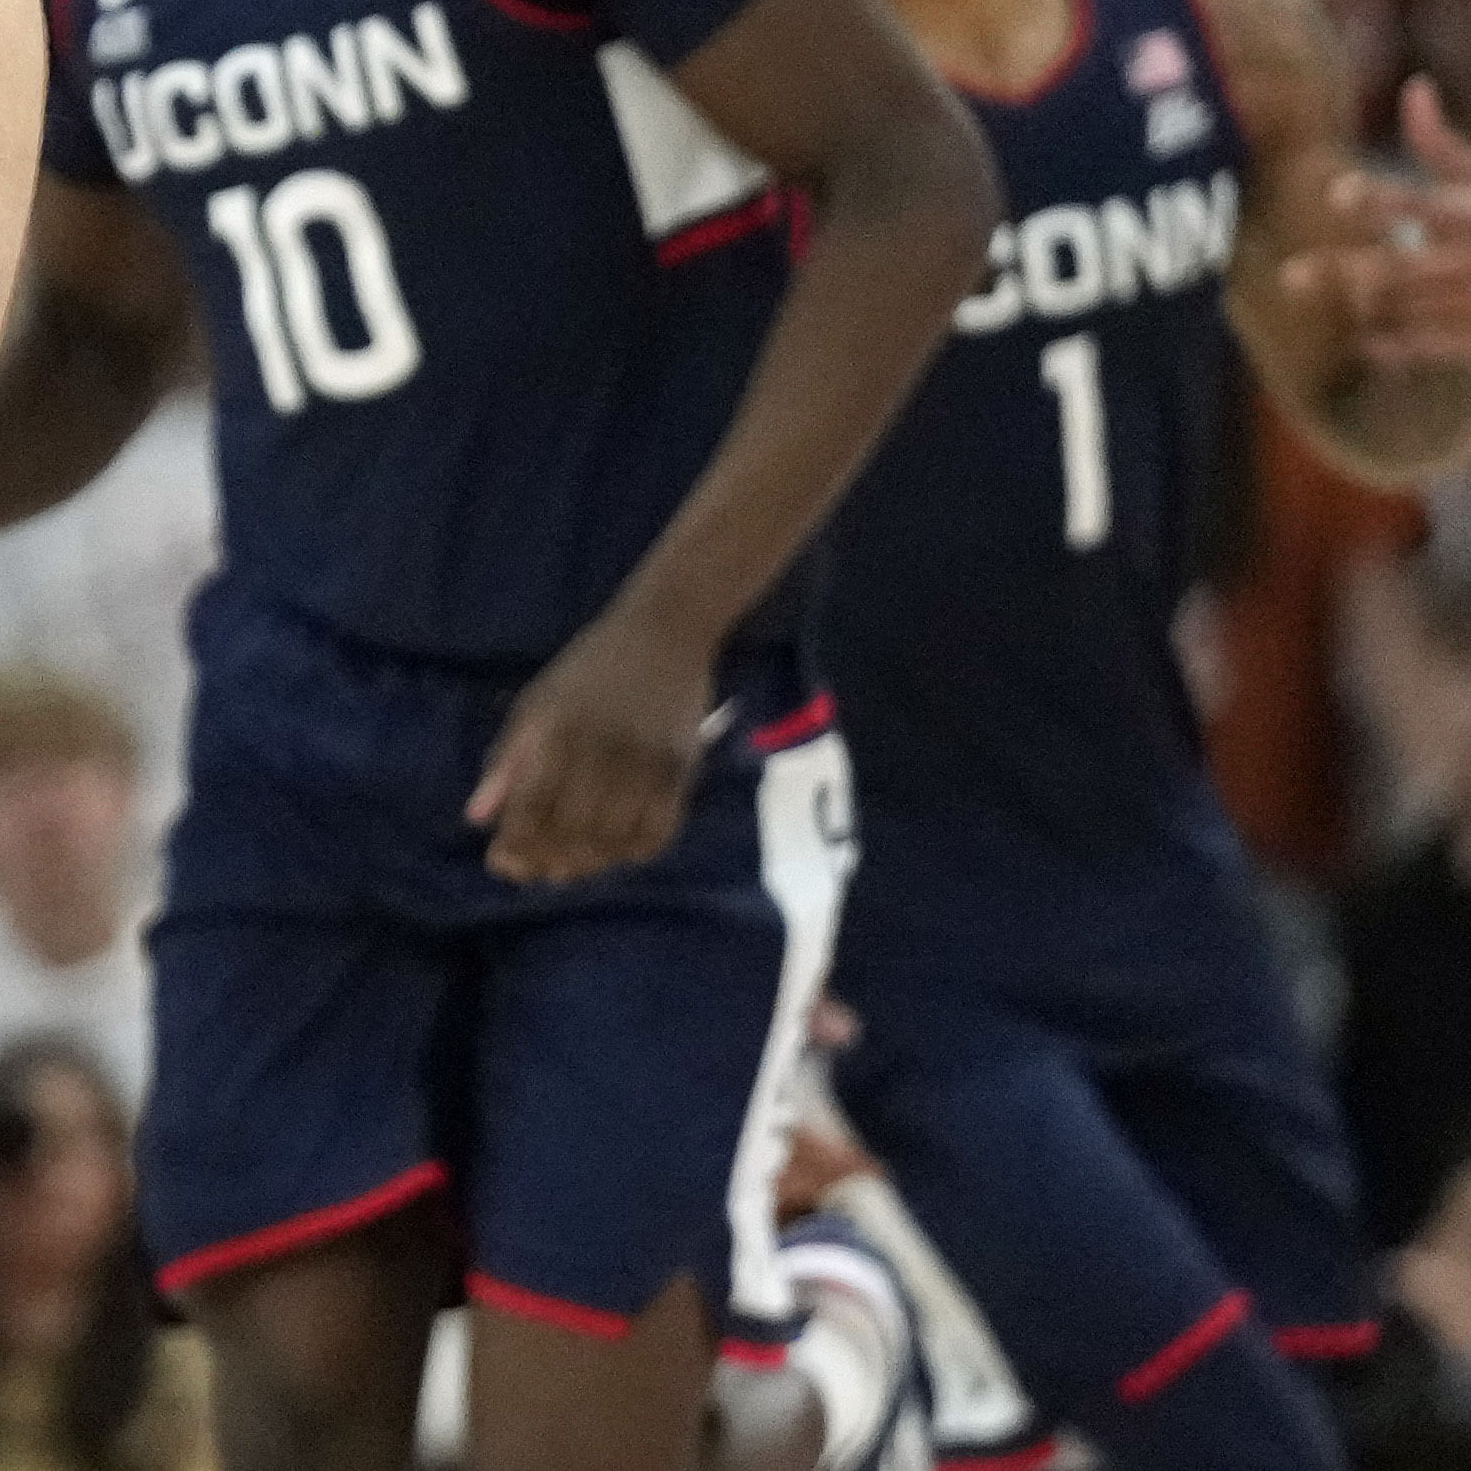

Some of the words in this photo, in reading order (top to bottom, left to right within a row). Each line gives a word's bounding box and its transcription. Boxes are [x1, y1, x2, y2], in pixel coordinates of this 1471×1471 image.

[92, 2, 469, 185] UCONN
[207, 168, 423, 415] 10
[953, 167, 1241, 334] CONN
[1039, 333, 1113, 552] 1
